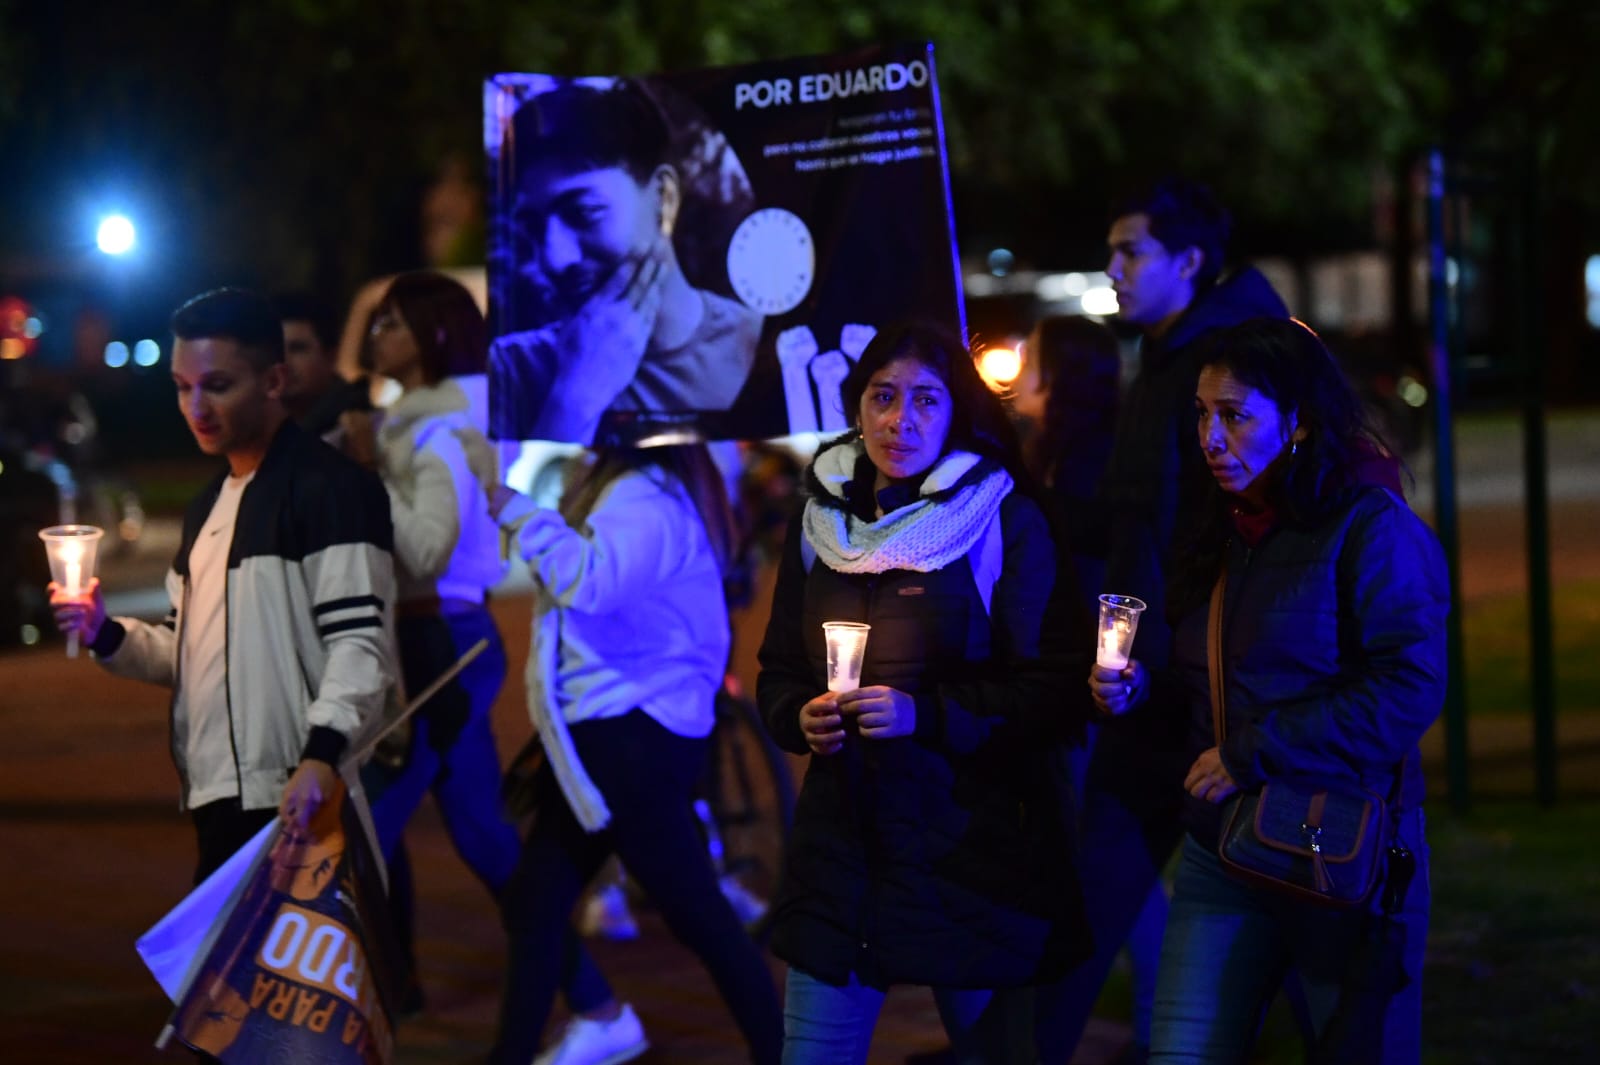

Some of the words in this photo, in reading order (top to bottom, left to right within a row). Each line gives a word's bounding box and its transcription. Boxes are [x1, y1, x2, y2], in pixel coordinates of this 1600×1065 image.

[735, 78, 793, 110] POR
[799, 60, 929, 103] EDUARDO
[252, 973, 337, 1033] PARA
